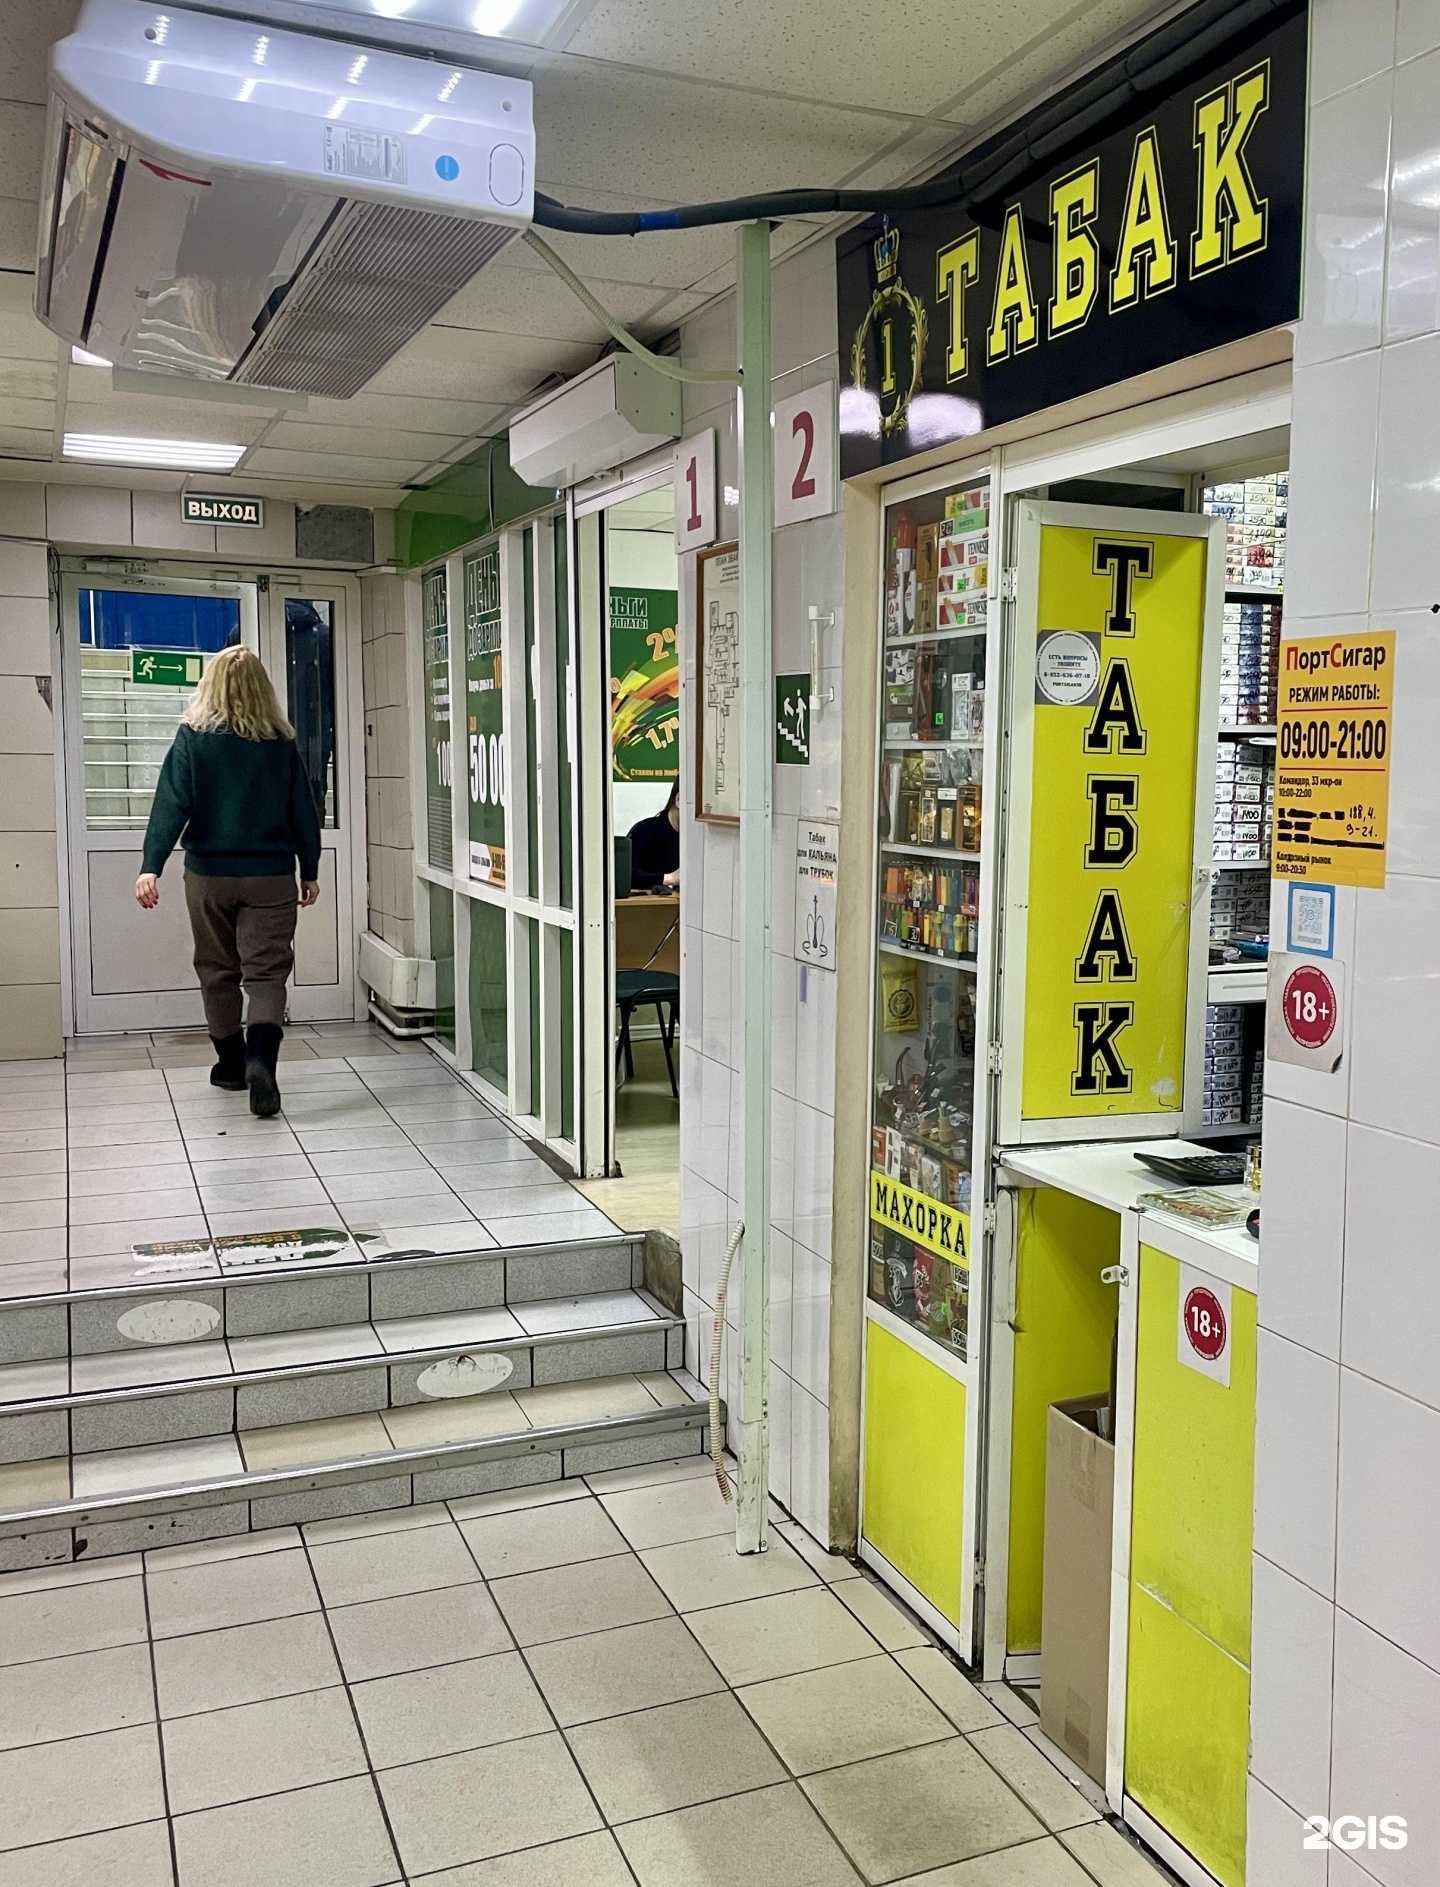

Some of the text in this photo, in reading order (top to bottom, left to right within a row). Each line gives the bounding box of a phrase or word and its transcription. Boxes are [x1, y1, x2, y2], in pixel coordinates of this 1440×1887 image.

[936, 57, 1270, 384] ТАБАК
[880, 318, 896, 398] 1
[791, 410, 816, 500] 2
[188, 501, 257, 522] ВЫХОД
[686, 456, 702, 532] 1
[1286, 643, 1386, 675] ПортСигар
[1289, 684, 1380, 703] РЕЖИМ РАБОТЫ:
[1281, 719, 1386, 760] 09:00-21:00
[1071, 537, 1154, 1096] ТАБАК
[808, 832, 826, 843] Табак
[1292, 989, 1330, 1023] 18+
[876, 1181, 968, 1257] МАХОРКА
[1191, 1306, 1221, 1338] 18+
